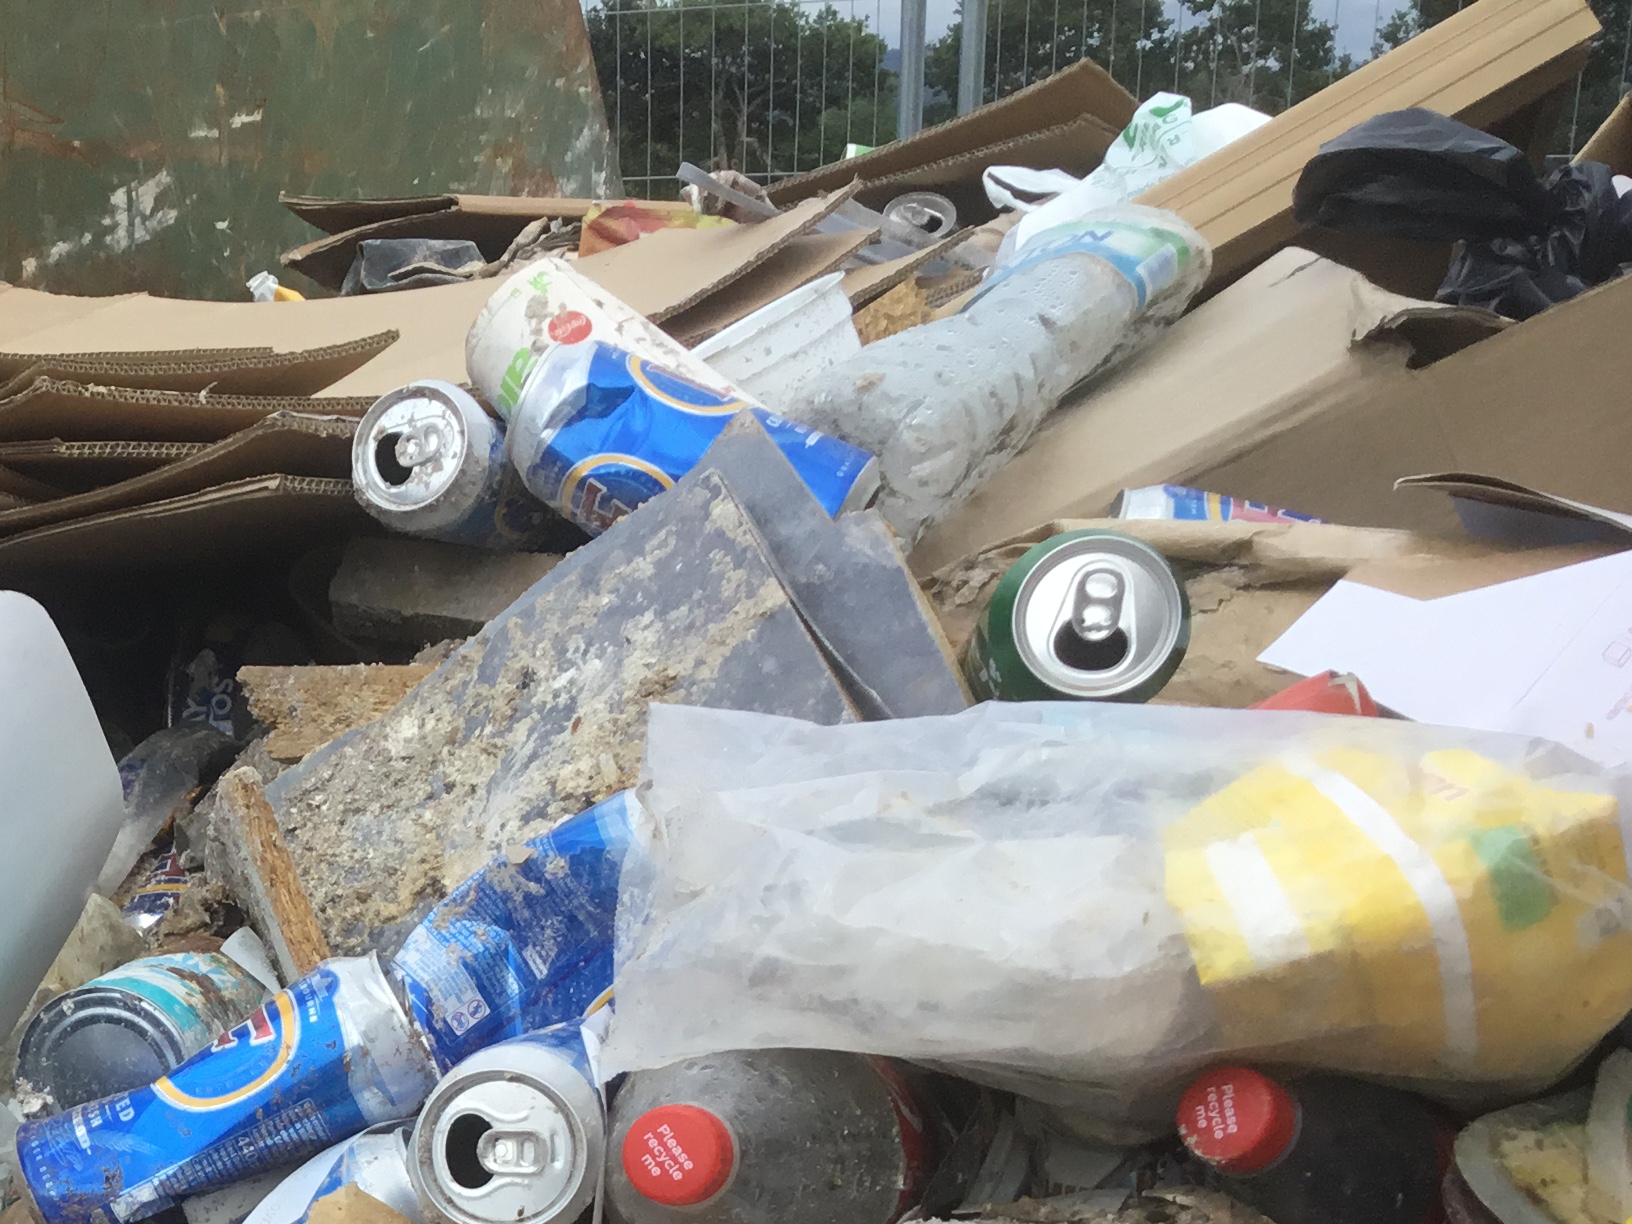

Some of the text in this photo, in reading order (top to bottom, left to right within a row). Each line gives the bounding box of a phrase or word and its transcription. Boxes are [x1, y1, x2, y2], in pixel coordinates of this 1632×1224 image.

[1195, 1105, 1207, 1129] me
[1207, 1087, 1225, 1140] recycle
[1221, 1084, 1238, 1134] Please
[641, 1153, 661, 1177] me
[644, 1132, 683, 1180] recycle
[657, 1124, 693, 1170] Please
